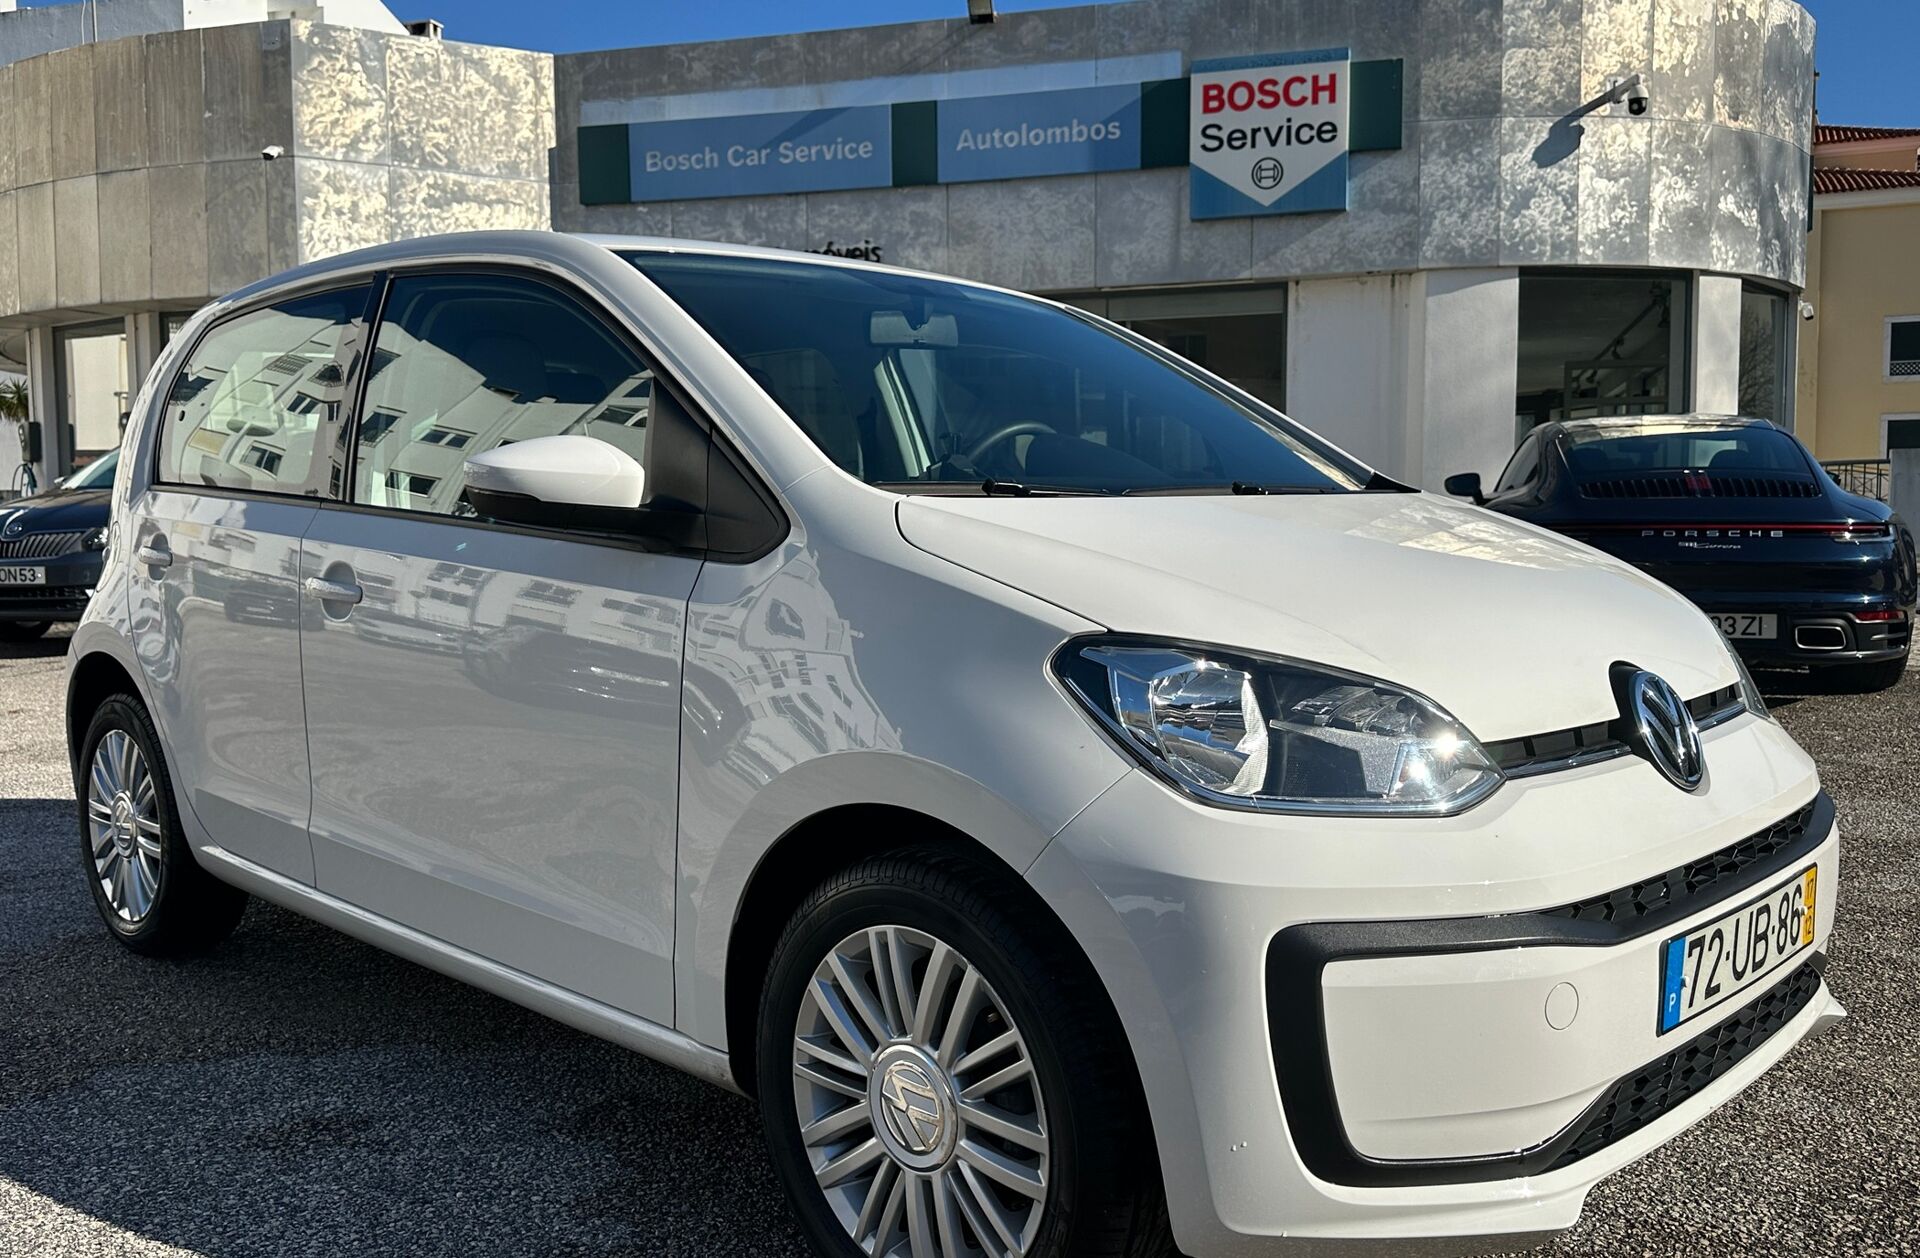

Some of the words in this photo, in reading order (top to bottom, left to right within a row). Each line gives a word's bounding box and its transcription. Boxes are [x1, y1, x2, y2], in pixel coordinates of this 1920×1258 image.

[1202, 73, 1337, 114] BOSCH
[956, 119, 1121, 151] Autolombos
[1200, 117, 1338, 153] Service
[645, 146, 719, 173] Bosch
[727, 144, 771, 168] Car
[778, 137, 873, 165] Service
[1669, 992, 1677, 1012] P
